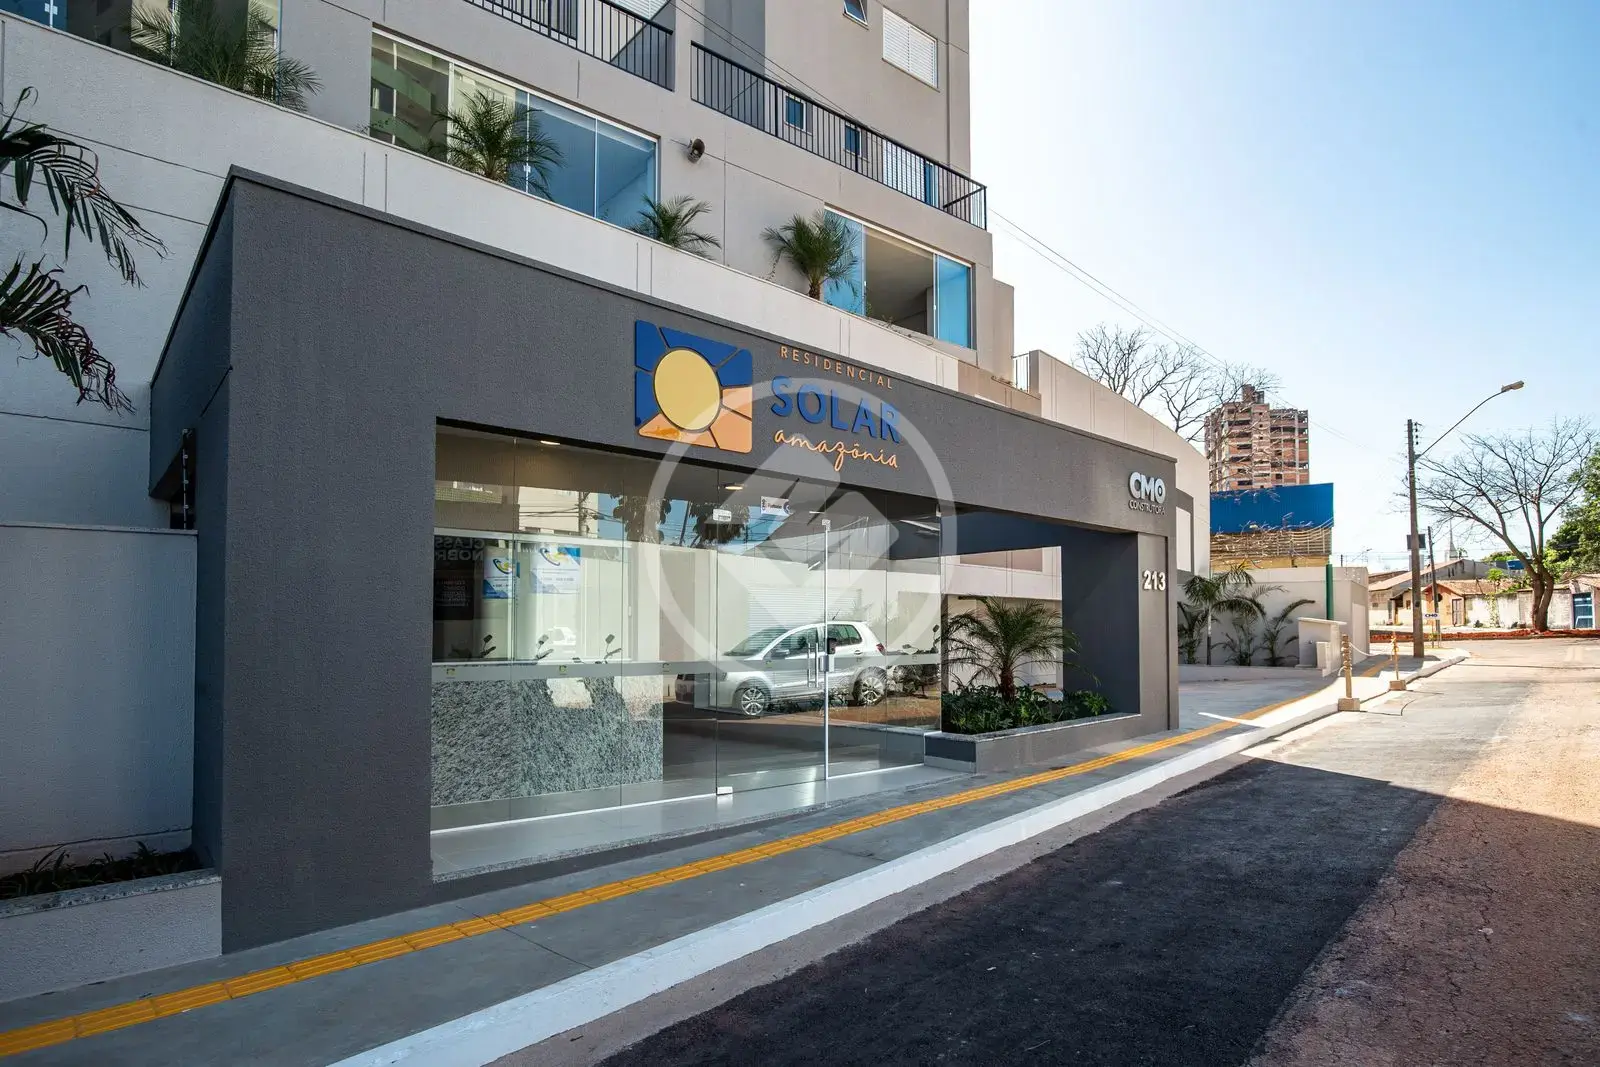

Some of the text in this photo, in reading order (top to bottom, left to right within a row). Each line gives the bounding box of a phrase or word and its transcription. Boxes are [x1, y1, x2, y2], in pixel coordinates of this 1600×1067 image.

[779, 345, 893, 389] RESIDENCIAL
[770, 376, 900, 444] SOLAR
[774, 429, 898, 471] amazônia
[1129, 472, 1166, 504] CMO
[1129, 500, 1166, 515] CONSTRUTORA
[1142, 570, 1166, 591] 213
